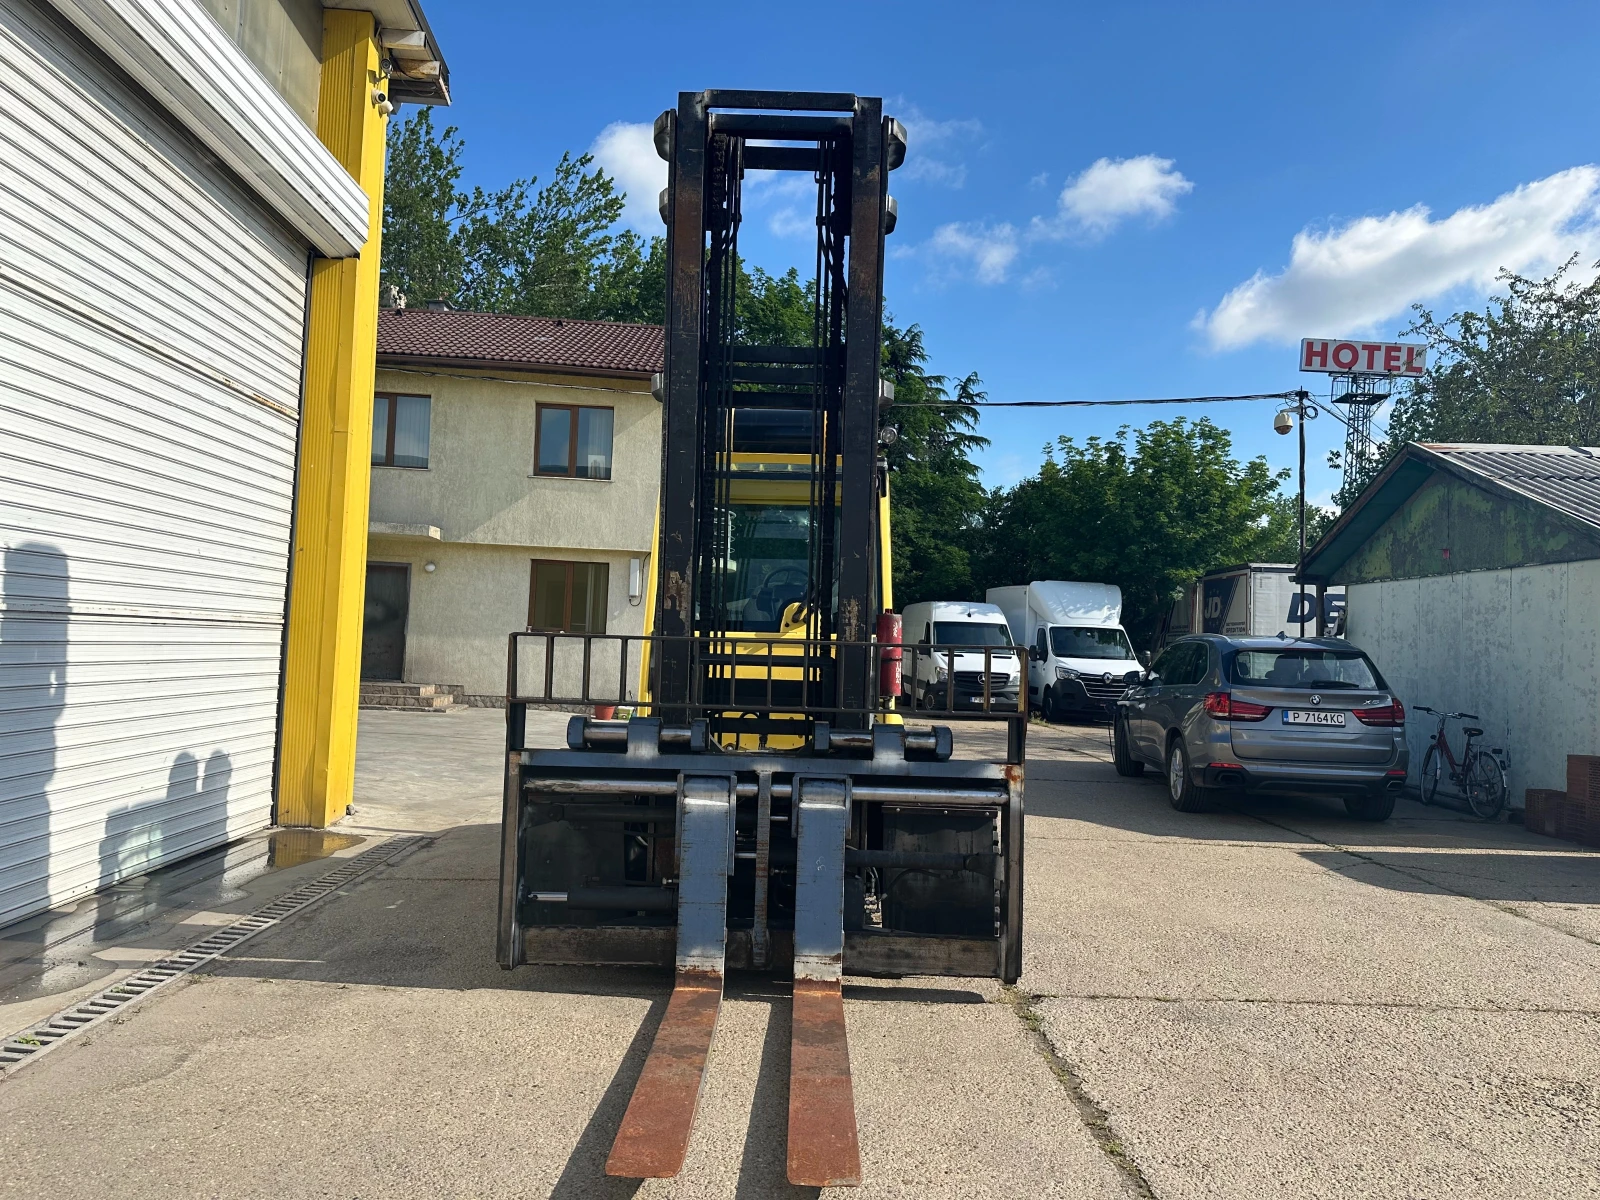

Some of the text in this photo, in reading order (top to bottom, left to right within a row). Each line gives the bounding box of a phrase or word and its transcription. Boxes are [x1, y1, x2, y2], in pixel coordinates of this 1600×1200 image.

[1304, 341, 1423, 373] HOTEL
[1204, 596, 1222, 619] JD
[1292, 712, 1300, 722] P
